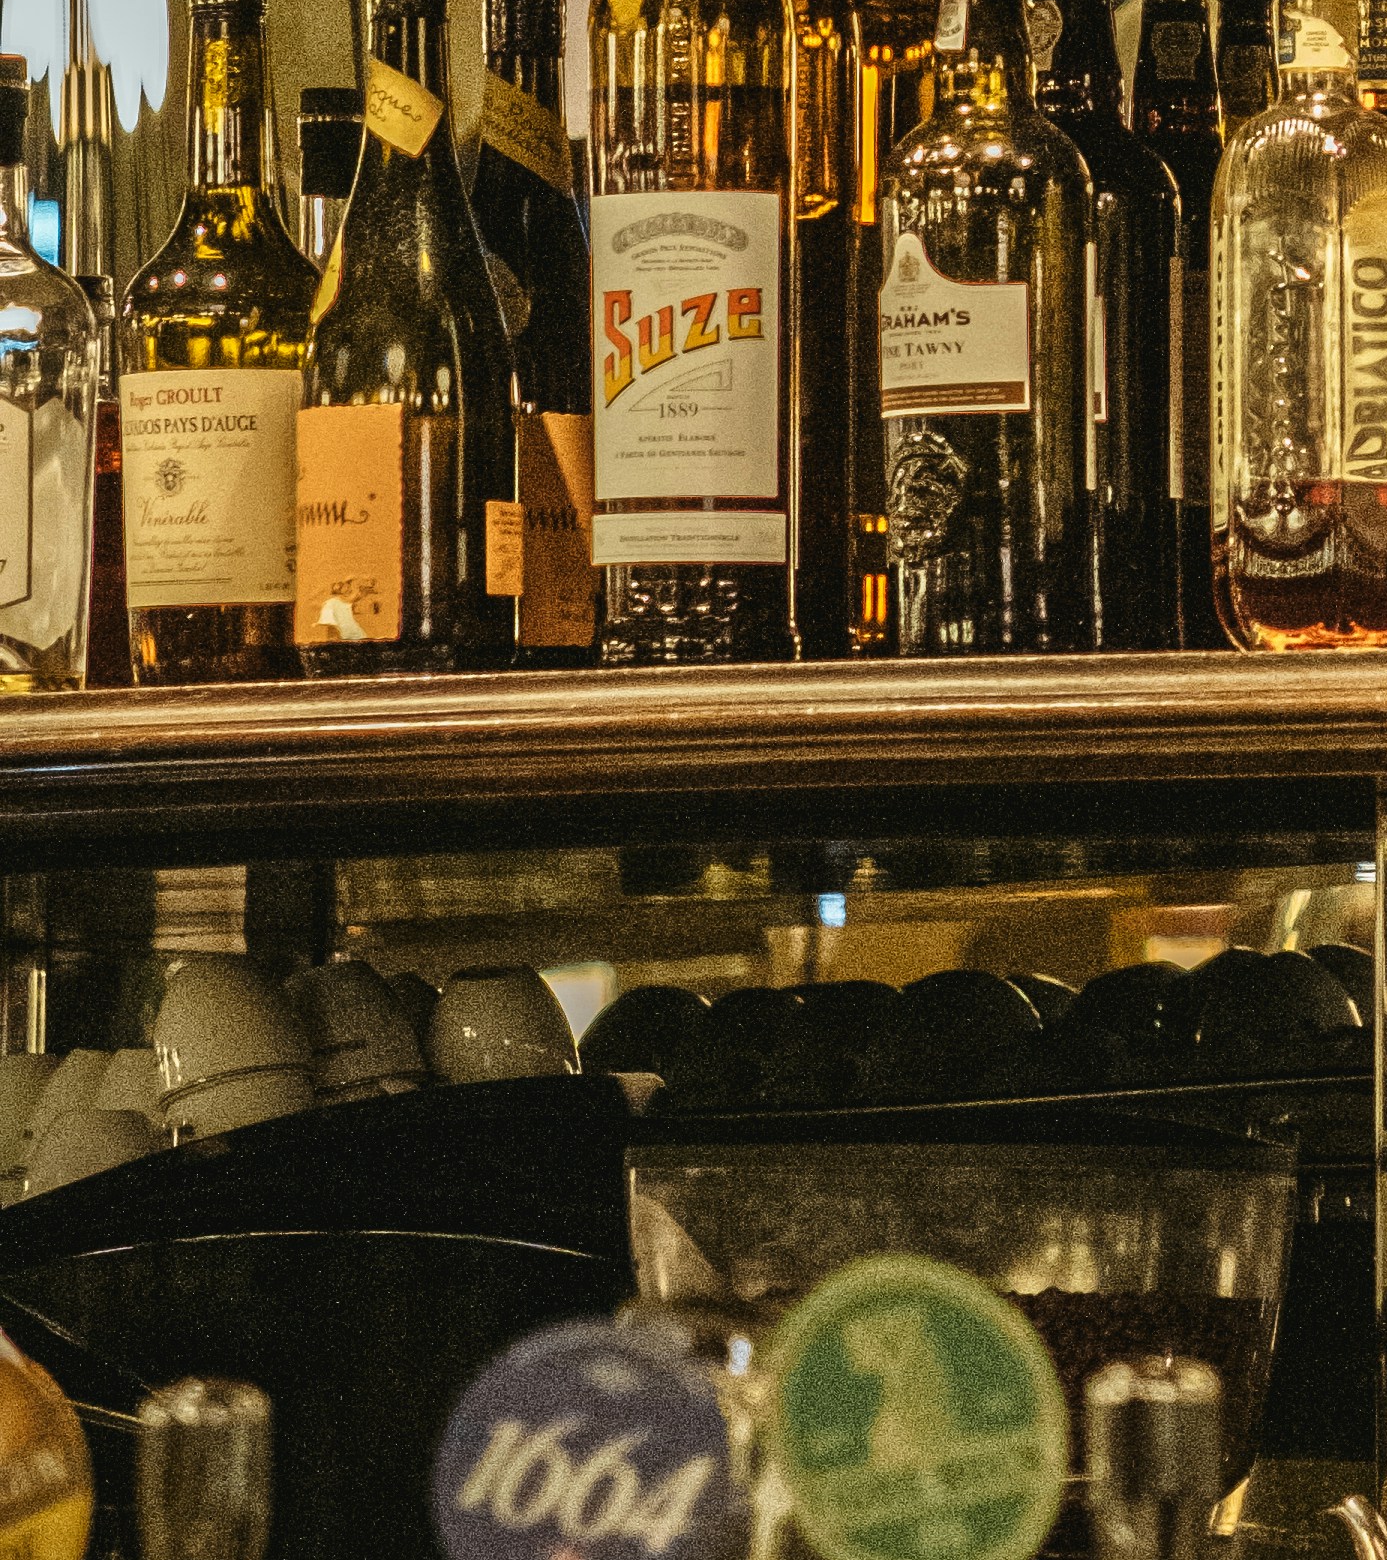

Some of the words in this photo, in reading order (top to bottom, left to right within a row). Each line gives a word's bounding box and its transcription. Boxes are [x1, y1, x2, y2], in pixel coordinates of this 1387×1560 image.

[603, 287, 765, 409] Suze
[905, 341, 966, 357] TAWNY
[129, 391, 152, 411] Roger
[156, 387, 223, 405] GROULT
[659, 403, 699, 420] 1889
[164, 416, 198, 434] PAYS
[202, 415, 257, 431] D'AUGE
[456, 1411, 716, 1553] 1664
